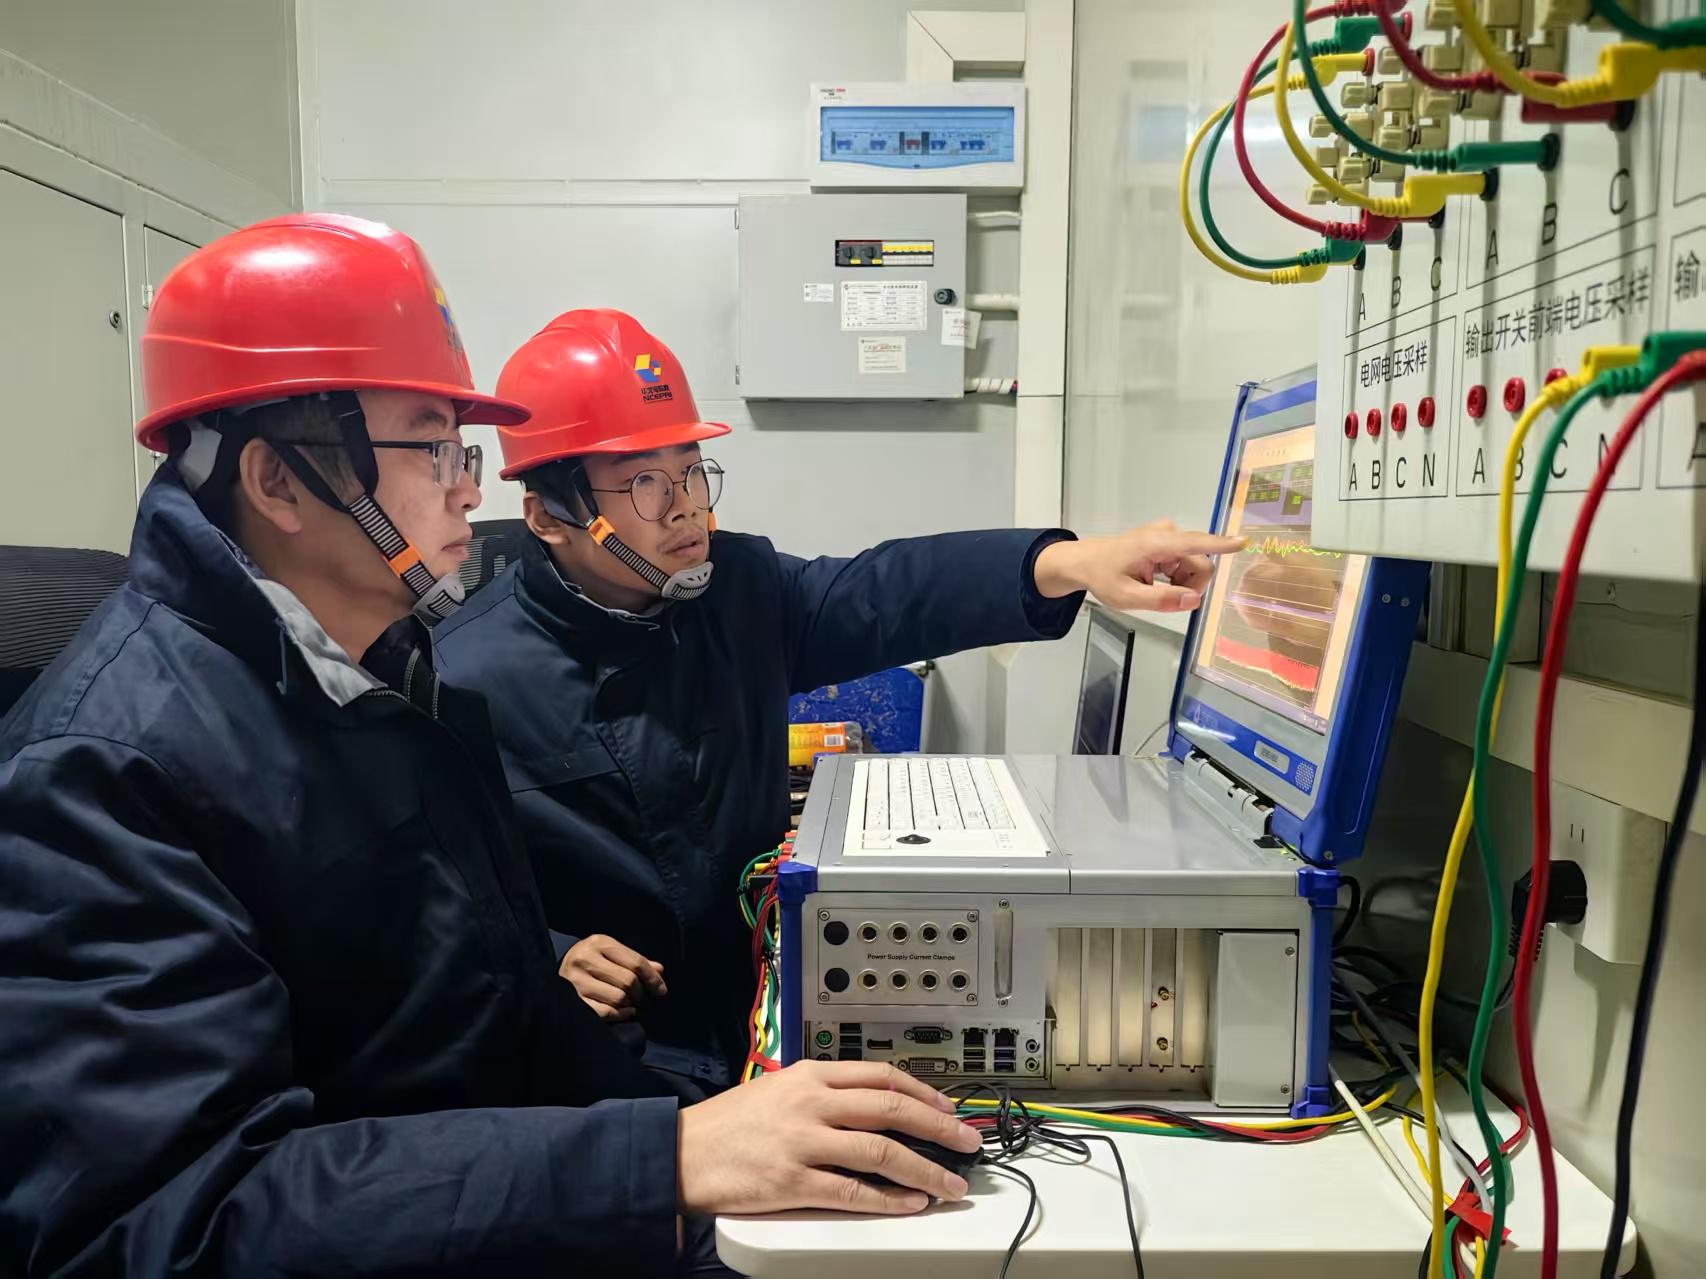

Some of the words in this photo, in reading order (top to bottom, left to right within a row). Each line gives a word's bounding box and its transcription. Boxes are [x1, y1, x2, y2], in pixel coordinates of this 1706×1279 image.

[1486, 229, 1499, 269] A
[1542, 202, 1558, 246] B
[1609, 168, 1630, 215] C
[1358, 293, 1367, 322] A
[1391, 275, 1402, 309] B
[1430, 256, 1442, 291] C
[1466, 266, 1649, 360] 输出开关前端电压采样
[1360, 340, 1428, 388] 电网电压采样
[1349, 462, 1358, 491] A
[1371, 460, 1381, 490] B
[1396, 456, 1407, 488] C
[1422, 453, 1436, 487] N
[1472, 448, 1486, 484] A
[887, 953, 908, 961] Supply
